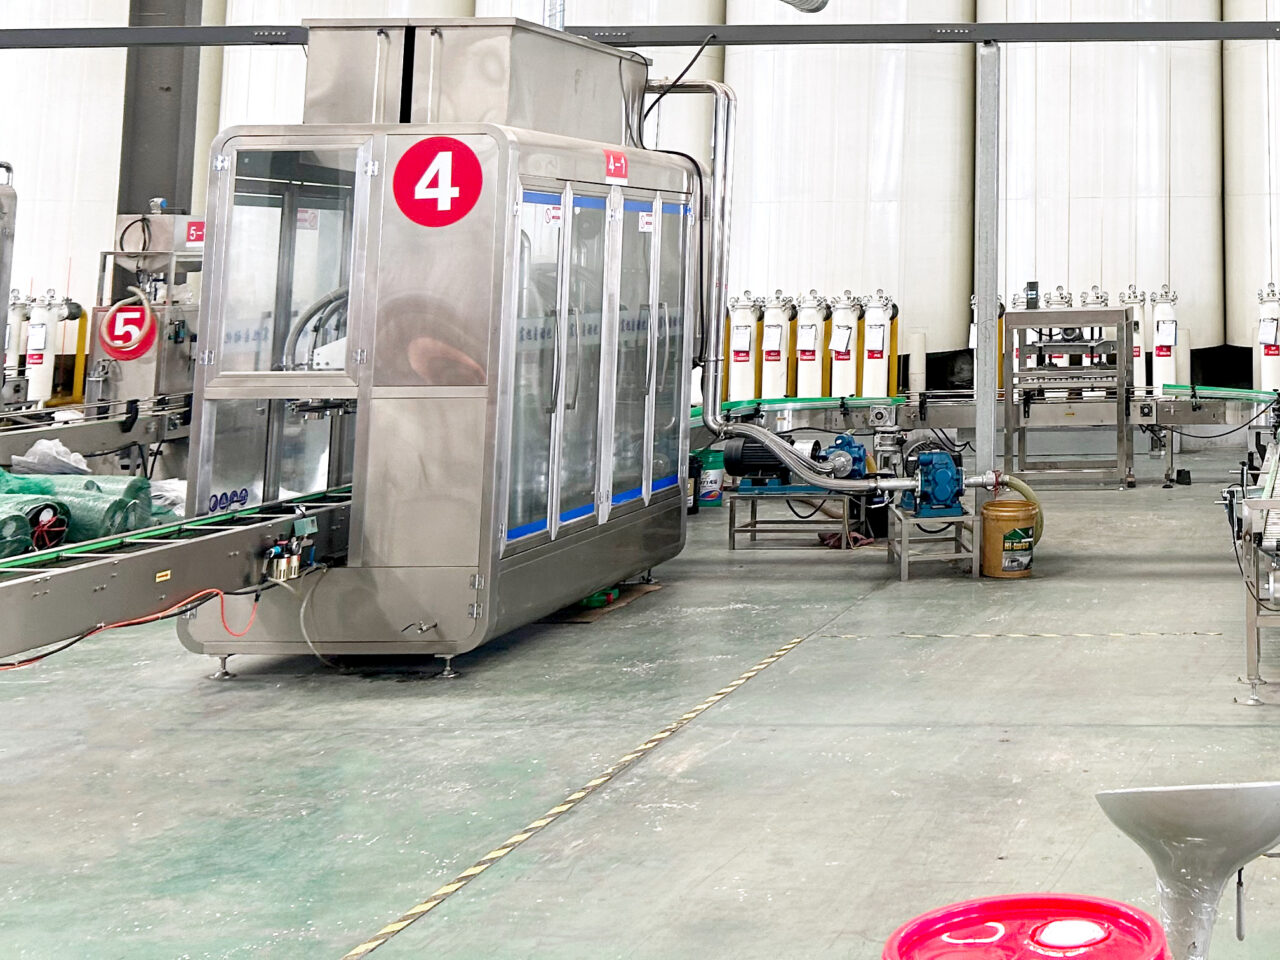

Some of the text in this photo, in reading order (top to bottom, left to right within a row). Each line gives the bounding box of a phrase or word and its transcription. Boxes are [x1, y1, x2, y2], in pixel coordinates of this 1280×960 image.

[608, 154, 626, 175] 4-1
[414, 151, 460, 211] 4
[190, 226, 205, 240] 5-
[113, 311, 142, 351] 5
